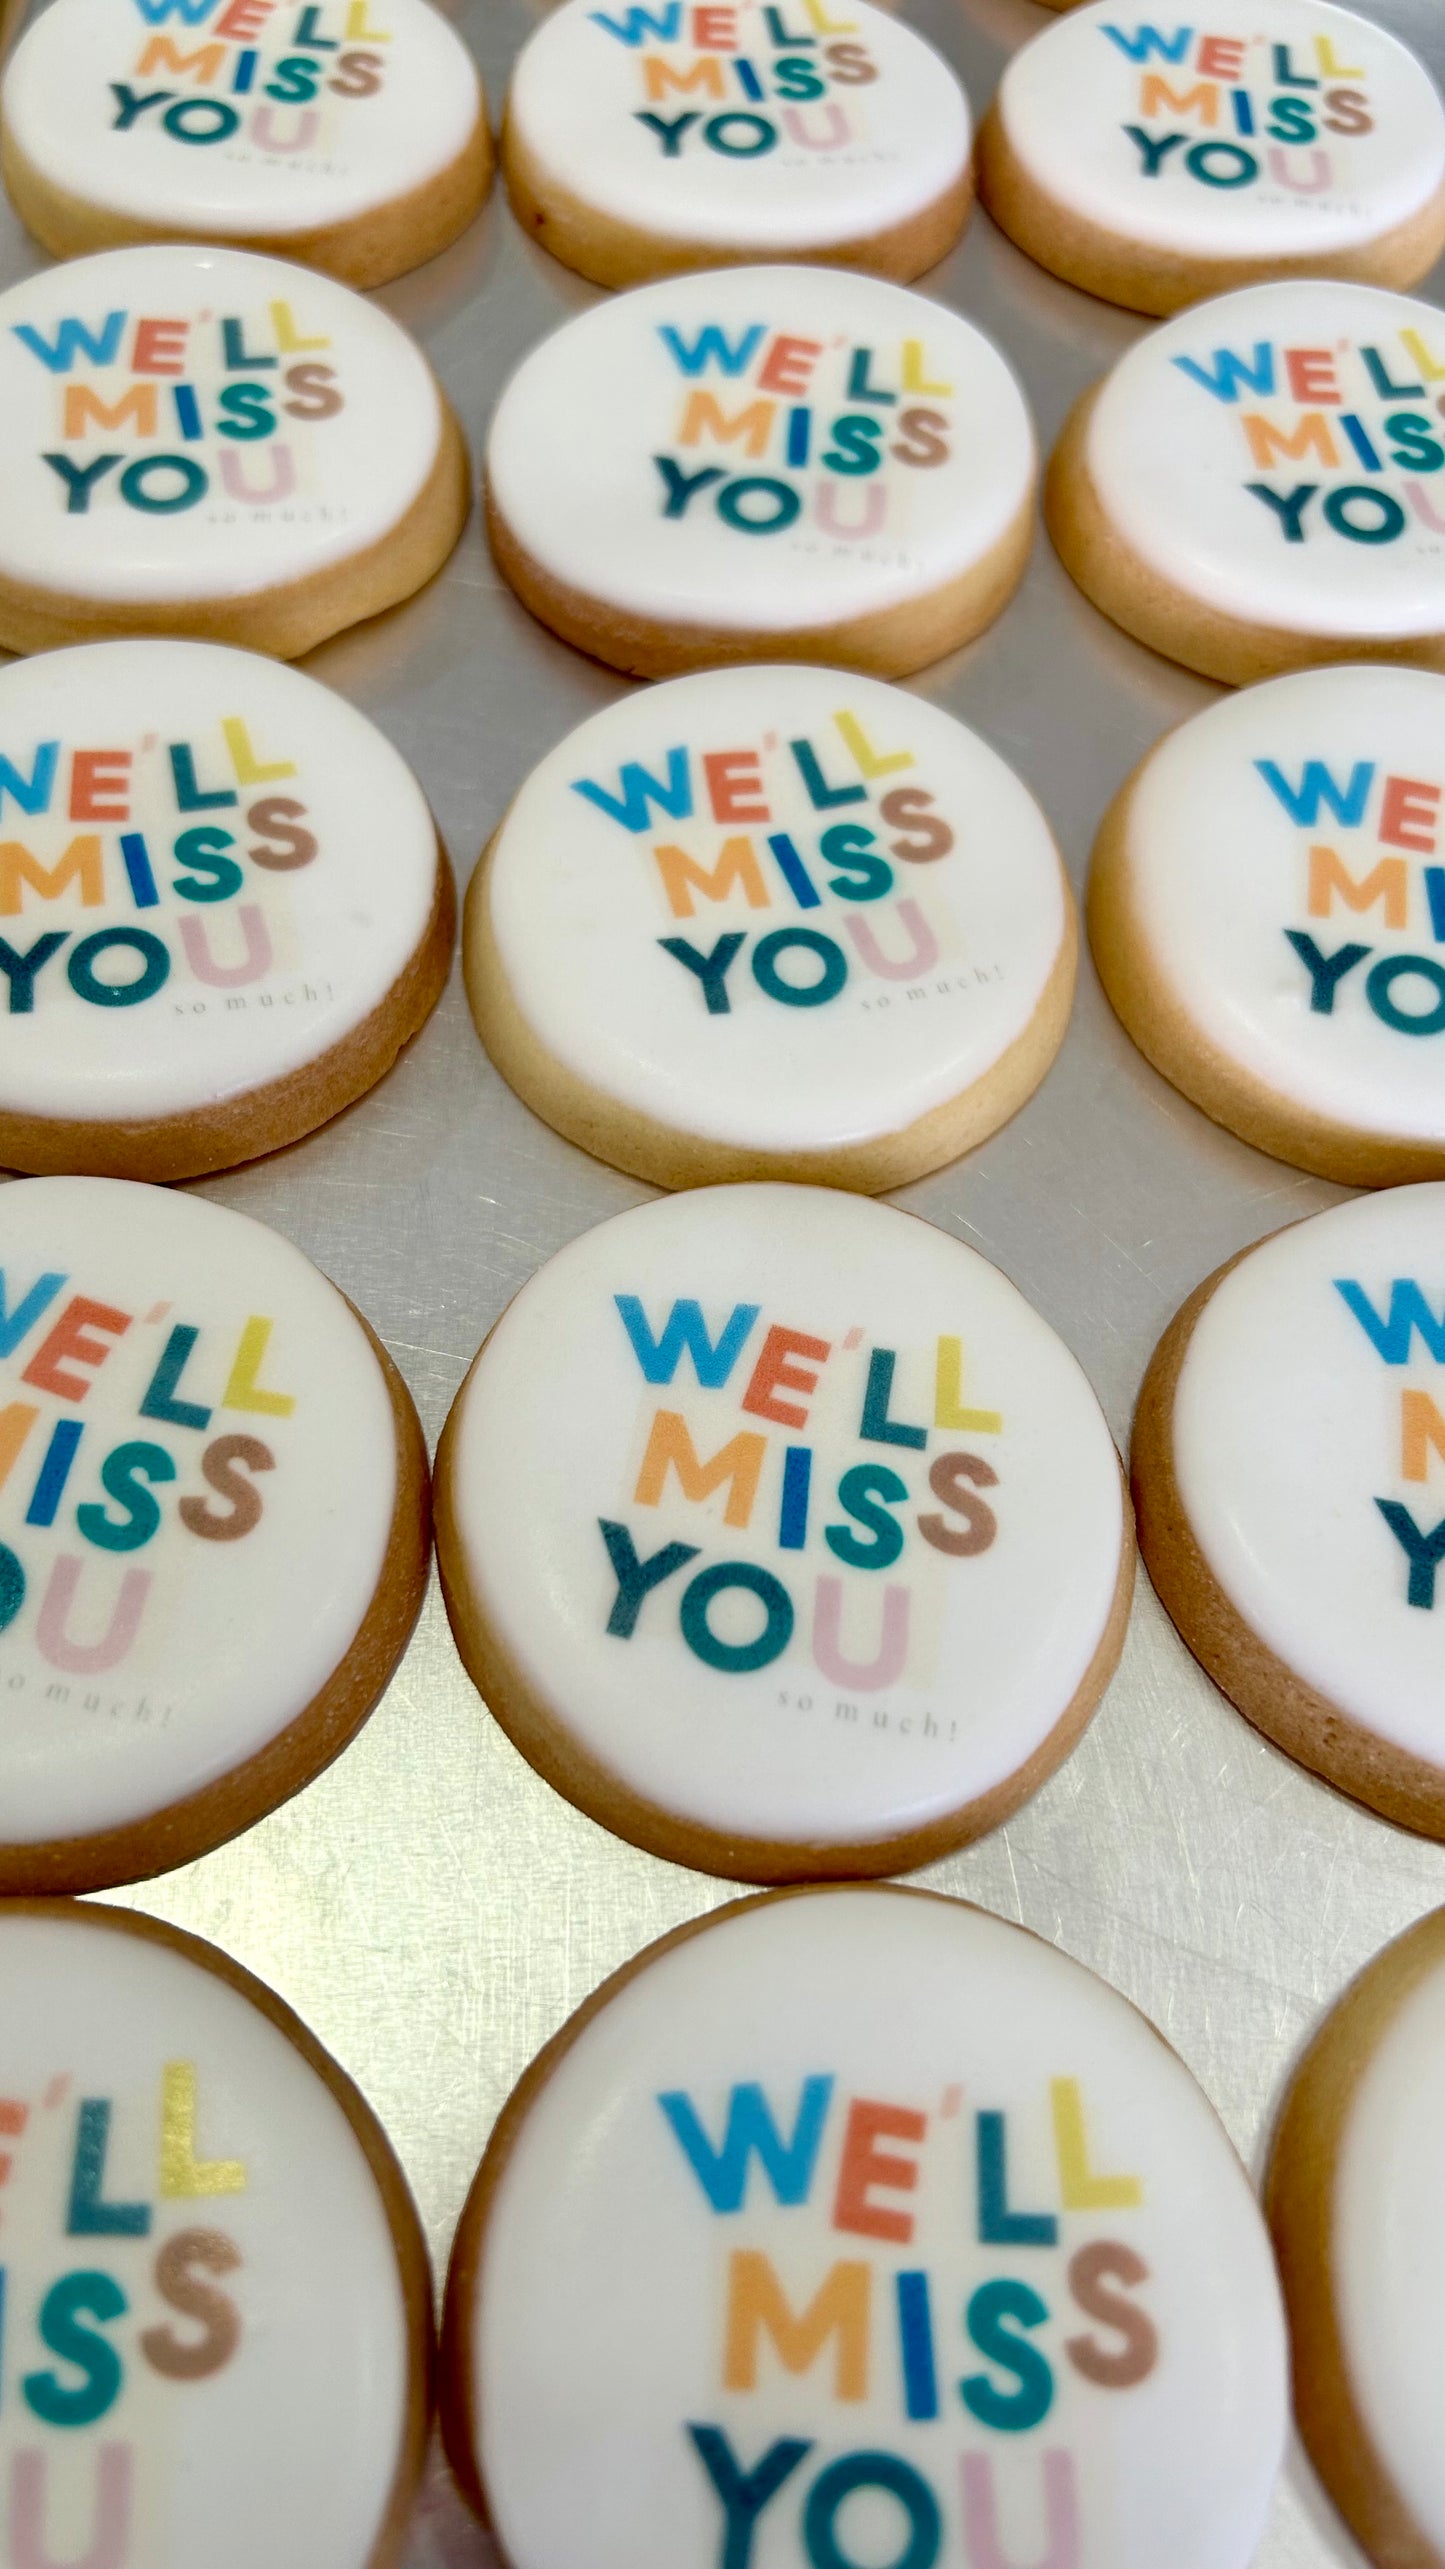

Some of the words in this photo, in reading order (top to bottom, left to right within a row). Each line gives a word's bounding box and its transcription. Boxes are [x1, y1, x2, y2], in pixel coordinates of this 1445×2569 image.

[134, 35, 382, 104] MISS
[642, 43, 879, 103] MISS
[1098, 24, 1366, 89] WE'LL
[110, 82, 320, 153] YOU
[634, 103, 852, 159] YOU
[1139, 74, 1374, 145] MISS
[1121, 125, 1333, 194] YOU
[11, 299, 331, 375] WE'LL
[656, 325, 952, 404] WE'LL
[1171, 328, 1445, 405] WE'LL
[64, 362, 345, 441] MISS
[677, 390, 951, 476] MISS
[1241, 393, 1445, 472] MIS
[42, 444, 297, 515] YOU
[652, 454, 888, 536] YOU
[569, 710, 916, 833] WE'LL
[1252, 760, 1440, 854] WE
[0, 797, 319, 917] MISS
[653, 787, 954, 918] MISS
[0, 903, 273, 1014] YOU
[656, 898, 939, 1015] YOU
[861, 995, 891, 1010] so
[905, 964, 1005, 1001] much!
[1282, 928, 1445, 1037] YO
[174, 1002, 207, 1014] so
[225, 982, 334, 1011] much!
[613, 1294, 1003, 1451] WE'LL
[633, 1409, 1000, 1571] MISS
[597, 1516, 911, 1693] YOU
[46, 1683, 173, 1728] much!
[778, 1690, 813, 1711] so
[835, 1701, 958, 1742] much!
[656, 2074, 1143, 2247] WE'LL
[0, 2227, 243, 2428] SS
[723, 2239, 1158, 2432] MISS
[685, 2419, 1081, 2569] YOU
